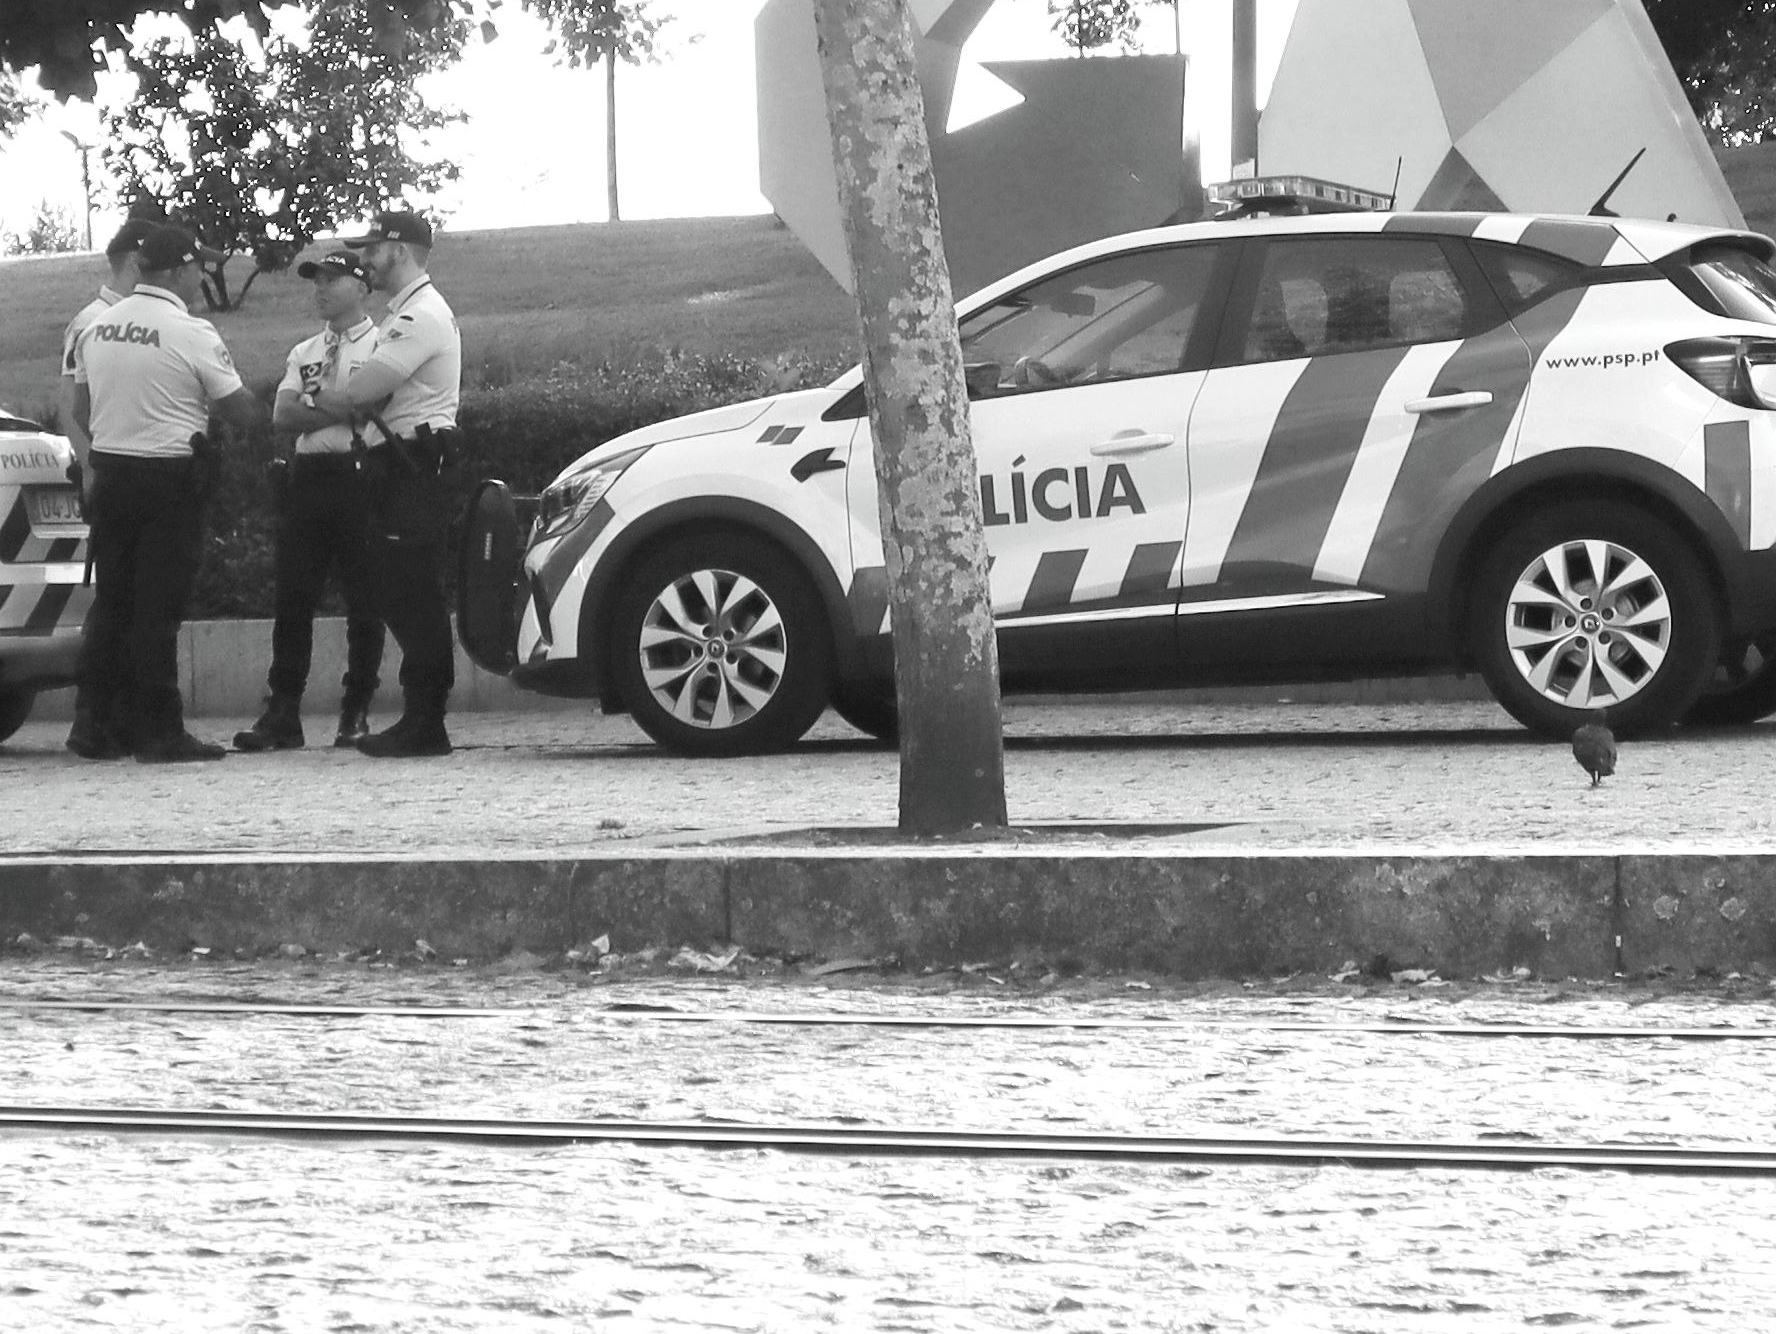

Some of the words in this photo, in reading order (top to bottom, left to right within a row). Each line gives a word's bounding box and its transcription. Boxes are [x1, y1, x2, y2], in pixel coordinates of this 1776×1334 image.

[94, 321, 160, 348] POLÍCIA
[1546, 350, 1659, 369] www.psp.pt
[0, 449, 60, 469] POLÍCIA
[980, 454, 1147, 527] LÍCIA
